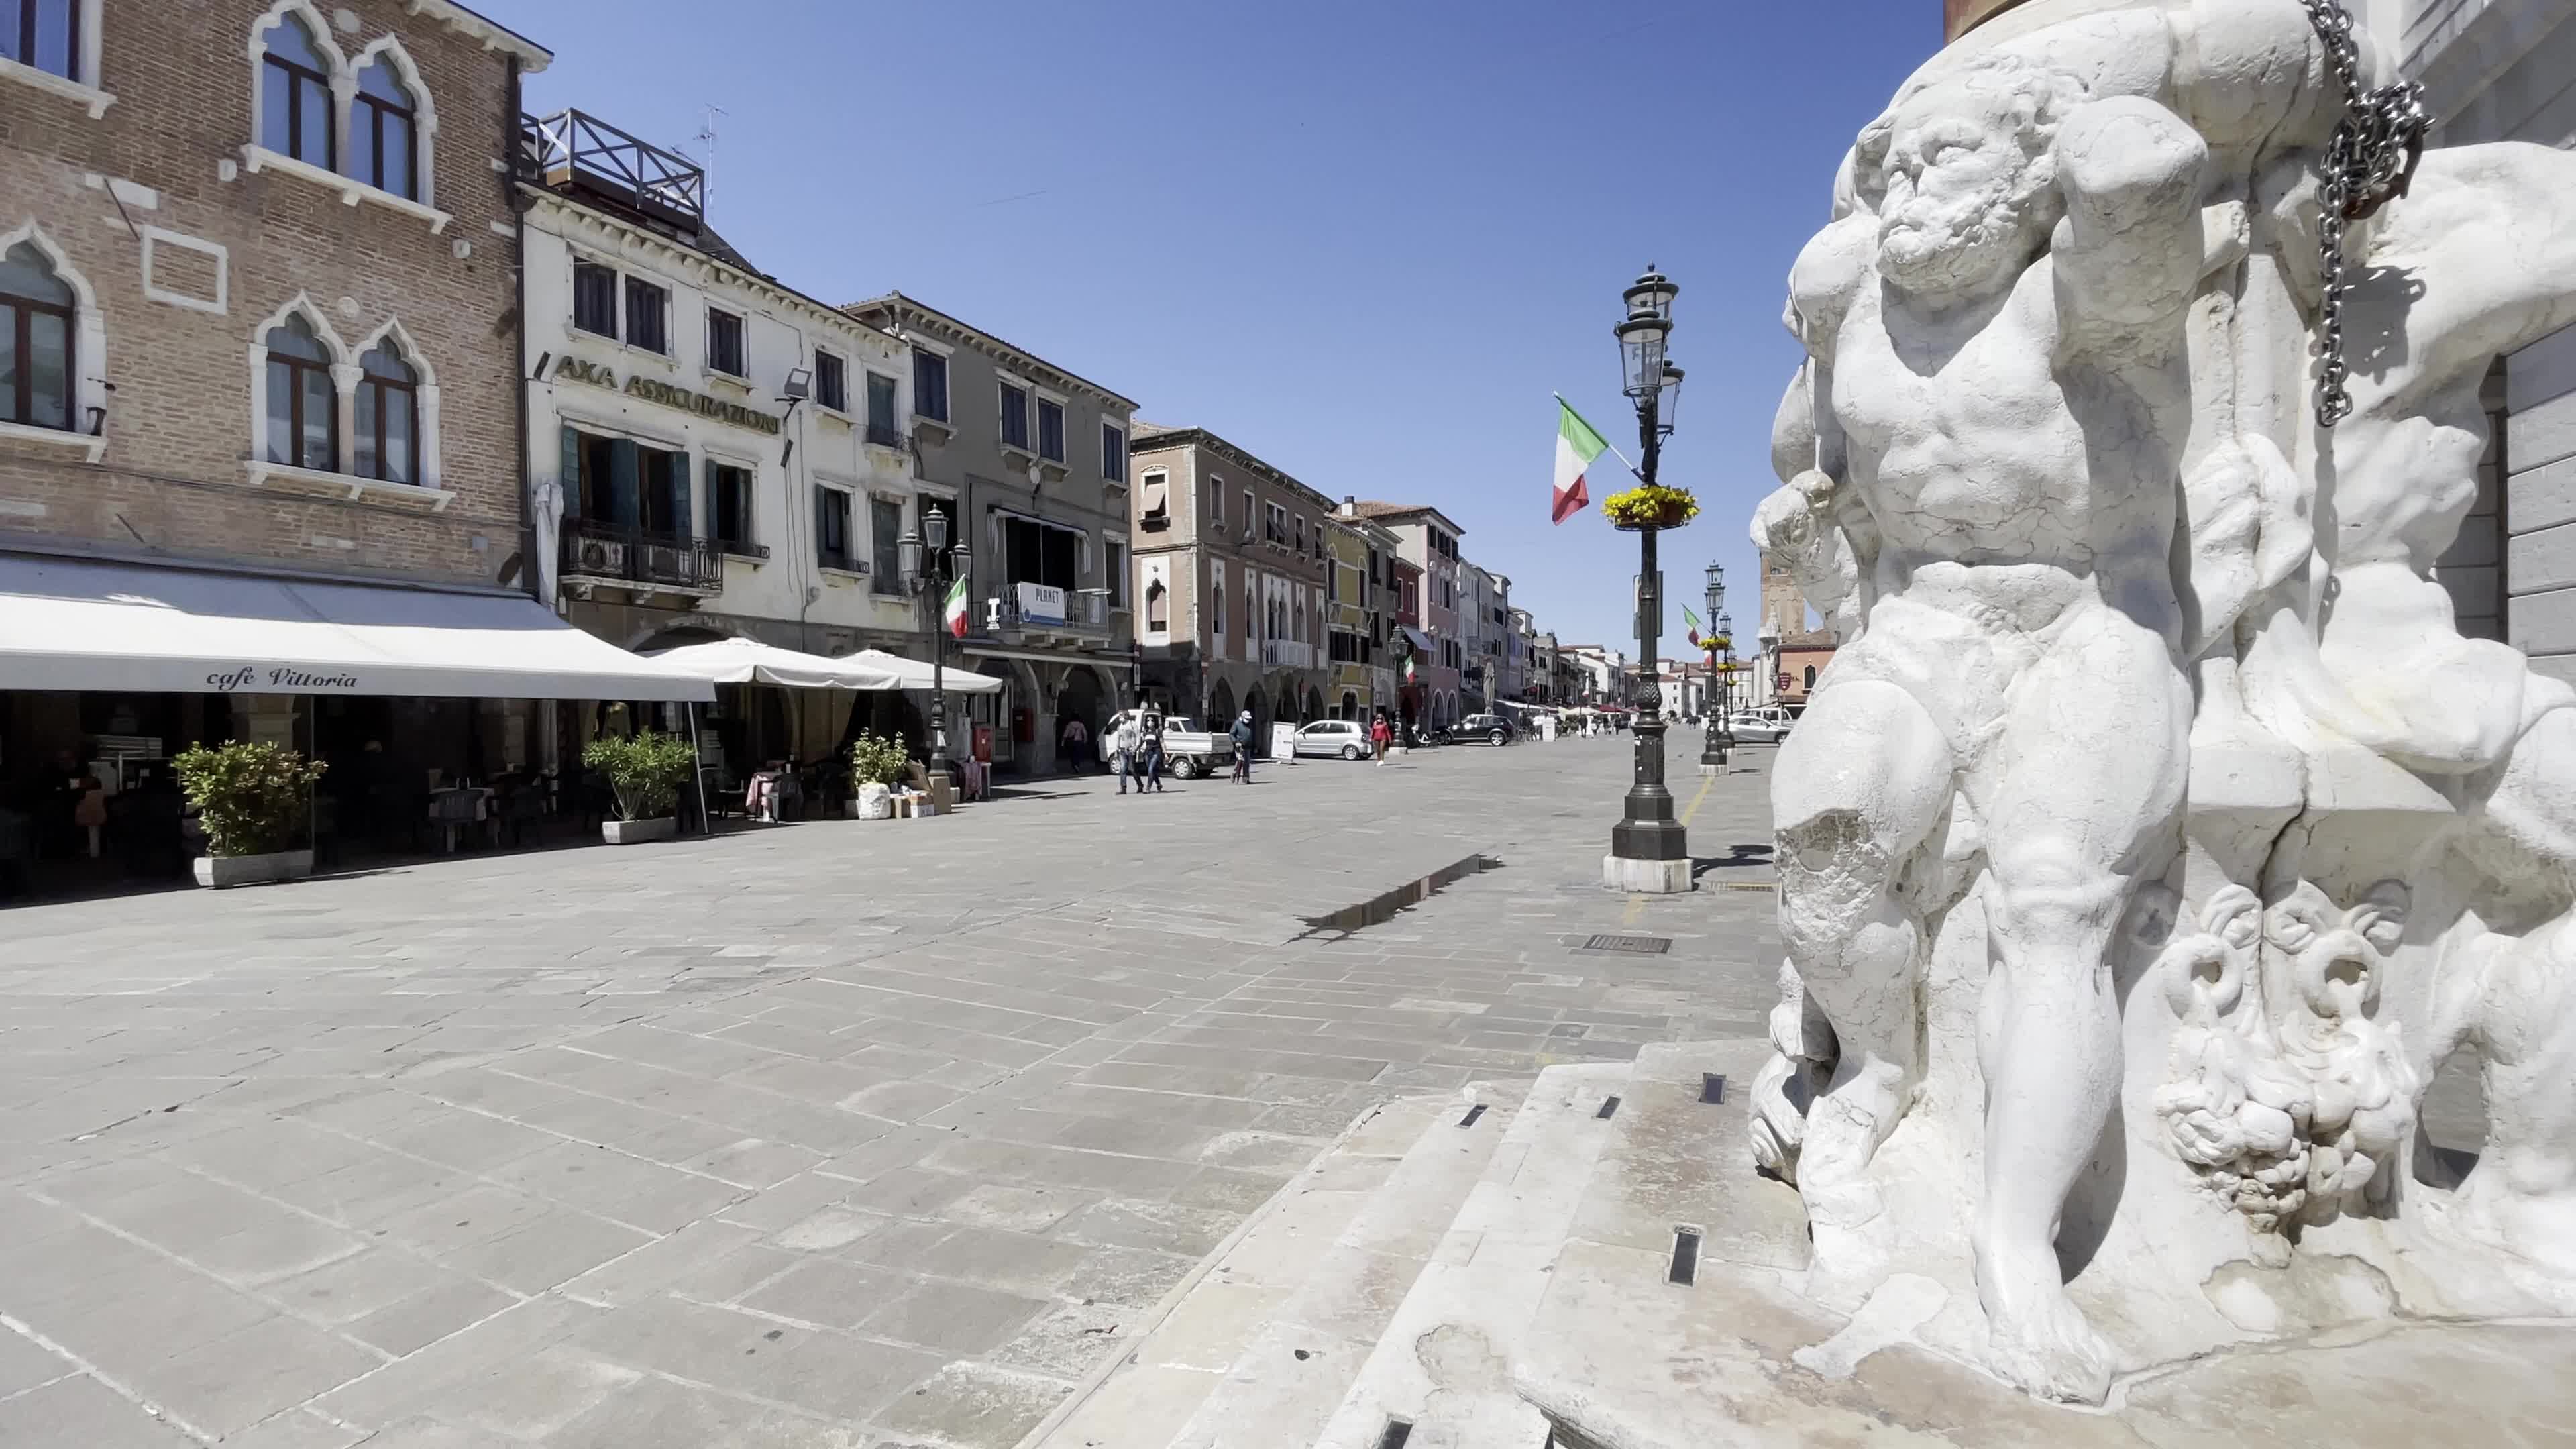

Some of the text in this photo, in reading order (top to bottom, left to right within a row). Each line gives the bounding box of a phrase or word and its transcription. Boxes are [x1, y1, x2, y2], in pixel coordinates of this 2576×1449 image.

[556, 355, 780, 435] AXA ASSICURAZIONI
[1035, 588, 1059, 604] PLANET
[269, 667, 358, 688] Vittoria
